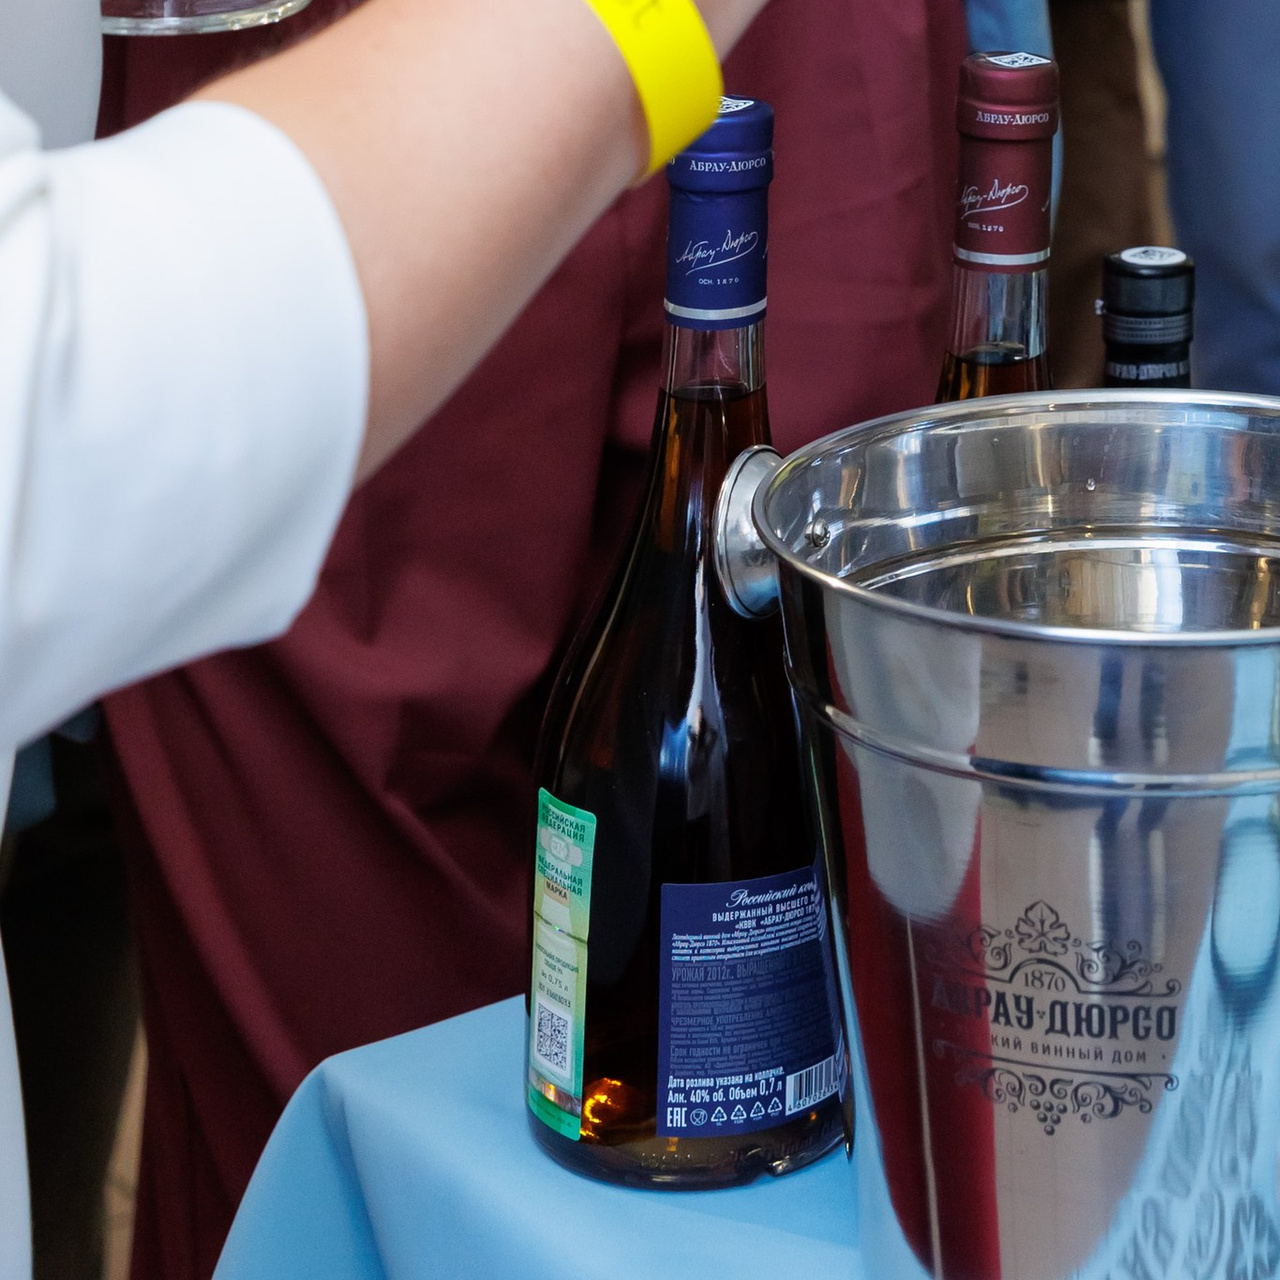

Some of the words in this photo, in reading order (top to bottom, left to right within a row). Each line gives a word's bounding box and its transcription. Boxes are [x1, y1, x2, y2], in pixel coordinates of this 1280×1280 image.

[976, 111, 1049, 125] АБРАУ-ДЮРСО
[690, 157, 766, 172] АБРАУ-ДЮРСО
[717, 277, 739, 285] 1870
[541, 812, 585, 843] ФЕДЕРАЦИЯ
[542, 803, 586, 834] РОССИЙСКАЯ
[537, 864, 582, 897] СПЕЦИАЛЬНАЯ
[538, 855, 583, 887] ФЕДЕРАЛЬНАЯ
[546, 881, 568, 900] МАРКА
[725, 884, 797, 908] Российский
[712, 904, 773, 922] ВЫДЕРЖАННЫЙ
[775, 898, 809, 913] ВЫСШЕГО
[671, 966, 705, 981] УРОЖАЯ
[1024, 971, 1066, 991] 1870
[671, 1015, 714, 1026] ЧРЕЗМЕРНОЕ
[670, 1045, 688, 1057] Срок
[689, 1044, 721, 1057] годности
[1031, 1045, 1103, 1062] ВИННЫЙ
[1112, 1050, 1147, 1064] ДОМ
[667, 1075, 684, 1089] Дата
[686, 1074, 714, 1088] розлива
[715, 1074, 743, 1088] указана
[745, 1073, 753, 1083] на
[754, 1065, 785, 1081] колпачке.
[667, 1090, 687, 1104] Алк.
[690, 1089, 710, 1102] 40%
[713, 1089, 726, 1102] об.
[729, 1086, 757, 1101] Объем
[759, 1078, 775, 1097] 0,7
[776, 1082, 782, 1092] л
